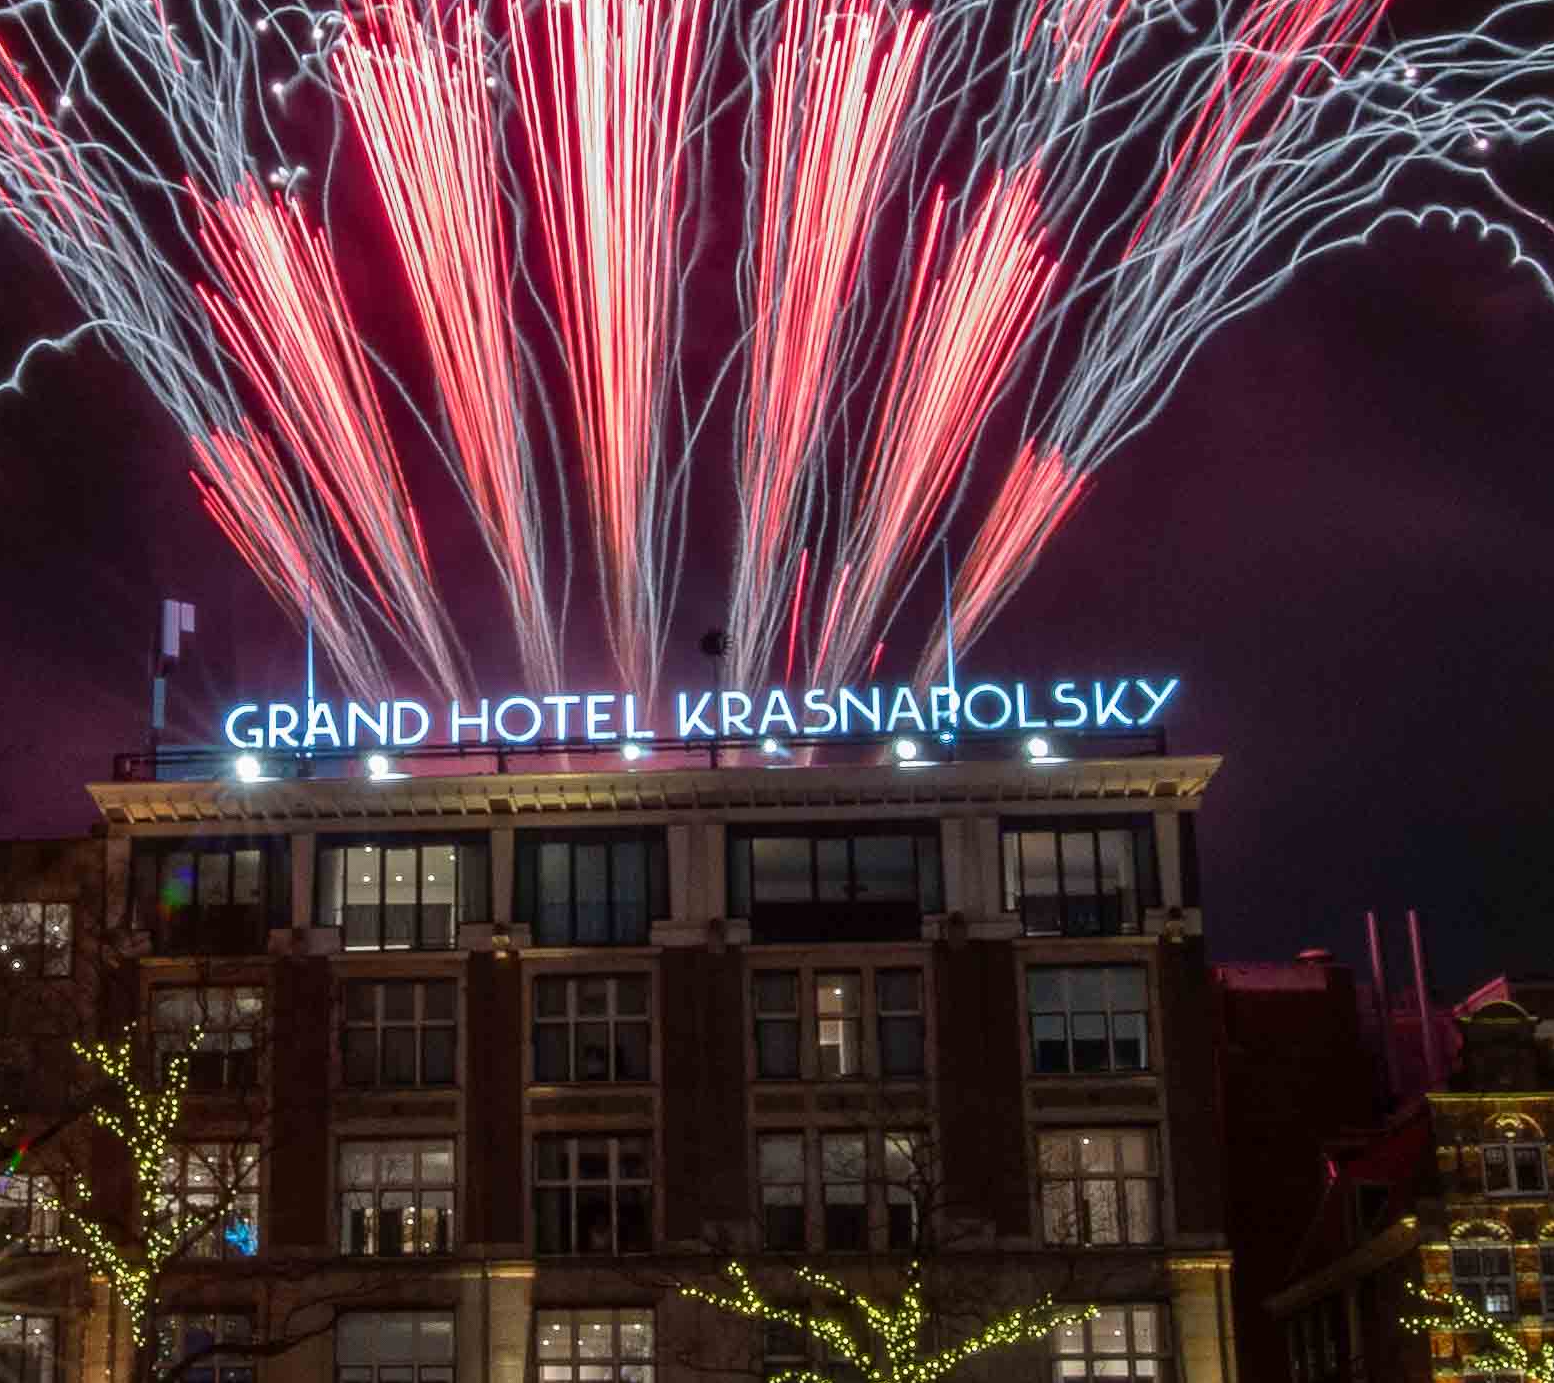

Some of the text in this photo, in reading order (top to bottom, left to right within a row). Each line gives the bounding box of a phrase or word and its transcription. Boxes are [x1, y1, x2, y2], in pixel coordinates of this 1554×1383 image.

[225, 676, 1180, 748] GRAND HOTEL KRASNAPOLSKY
